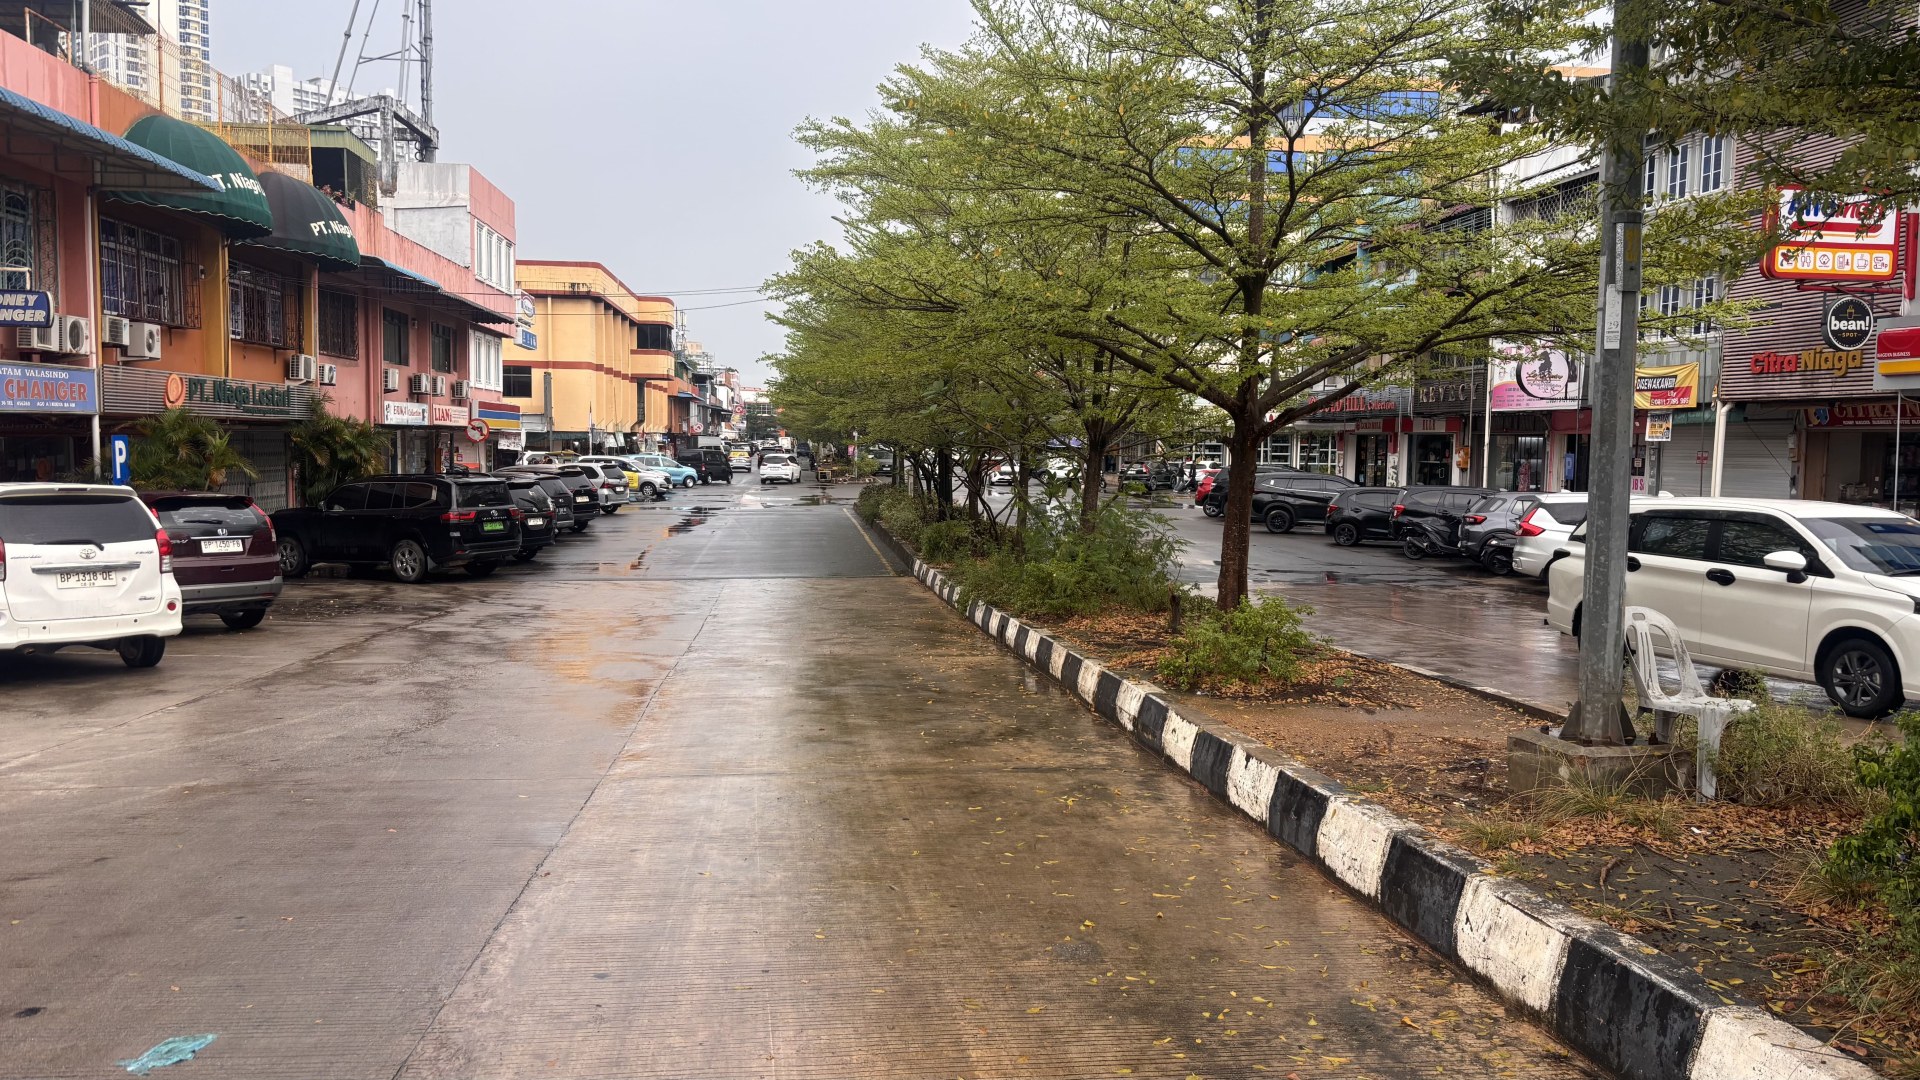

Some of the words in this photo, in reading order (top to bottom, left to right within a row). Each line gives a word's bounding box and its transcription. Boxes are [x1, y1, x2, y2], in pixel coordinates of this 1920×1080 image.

[310, 221, 332, 236] PT.
[0, 293, 38, 307] NEY
[0, 309, 46, 322] NGER
[1831, 316, 1870, 330] bean!
[1750, 350, 1798, 374] Citra
[1800, 345, 1864, 377] Niaga
[25, 369, 69, 380] VALASINDO
[4, 378, 88, 402] CHANGER
[188, 378, 209, 401] PT.
[213, 379, 250, 409] Niaga
[252, 384, 291, 407] Lestari
[1834, 402, 1897, 417] CITRA
[115, 440, 126, 479] P
[60, 573, 72, 583] BP
[75, 571, 98, 581] 1318
